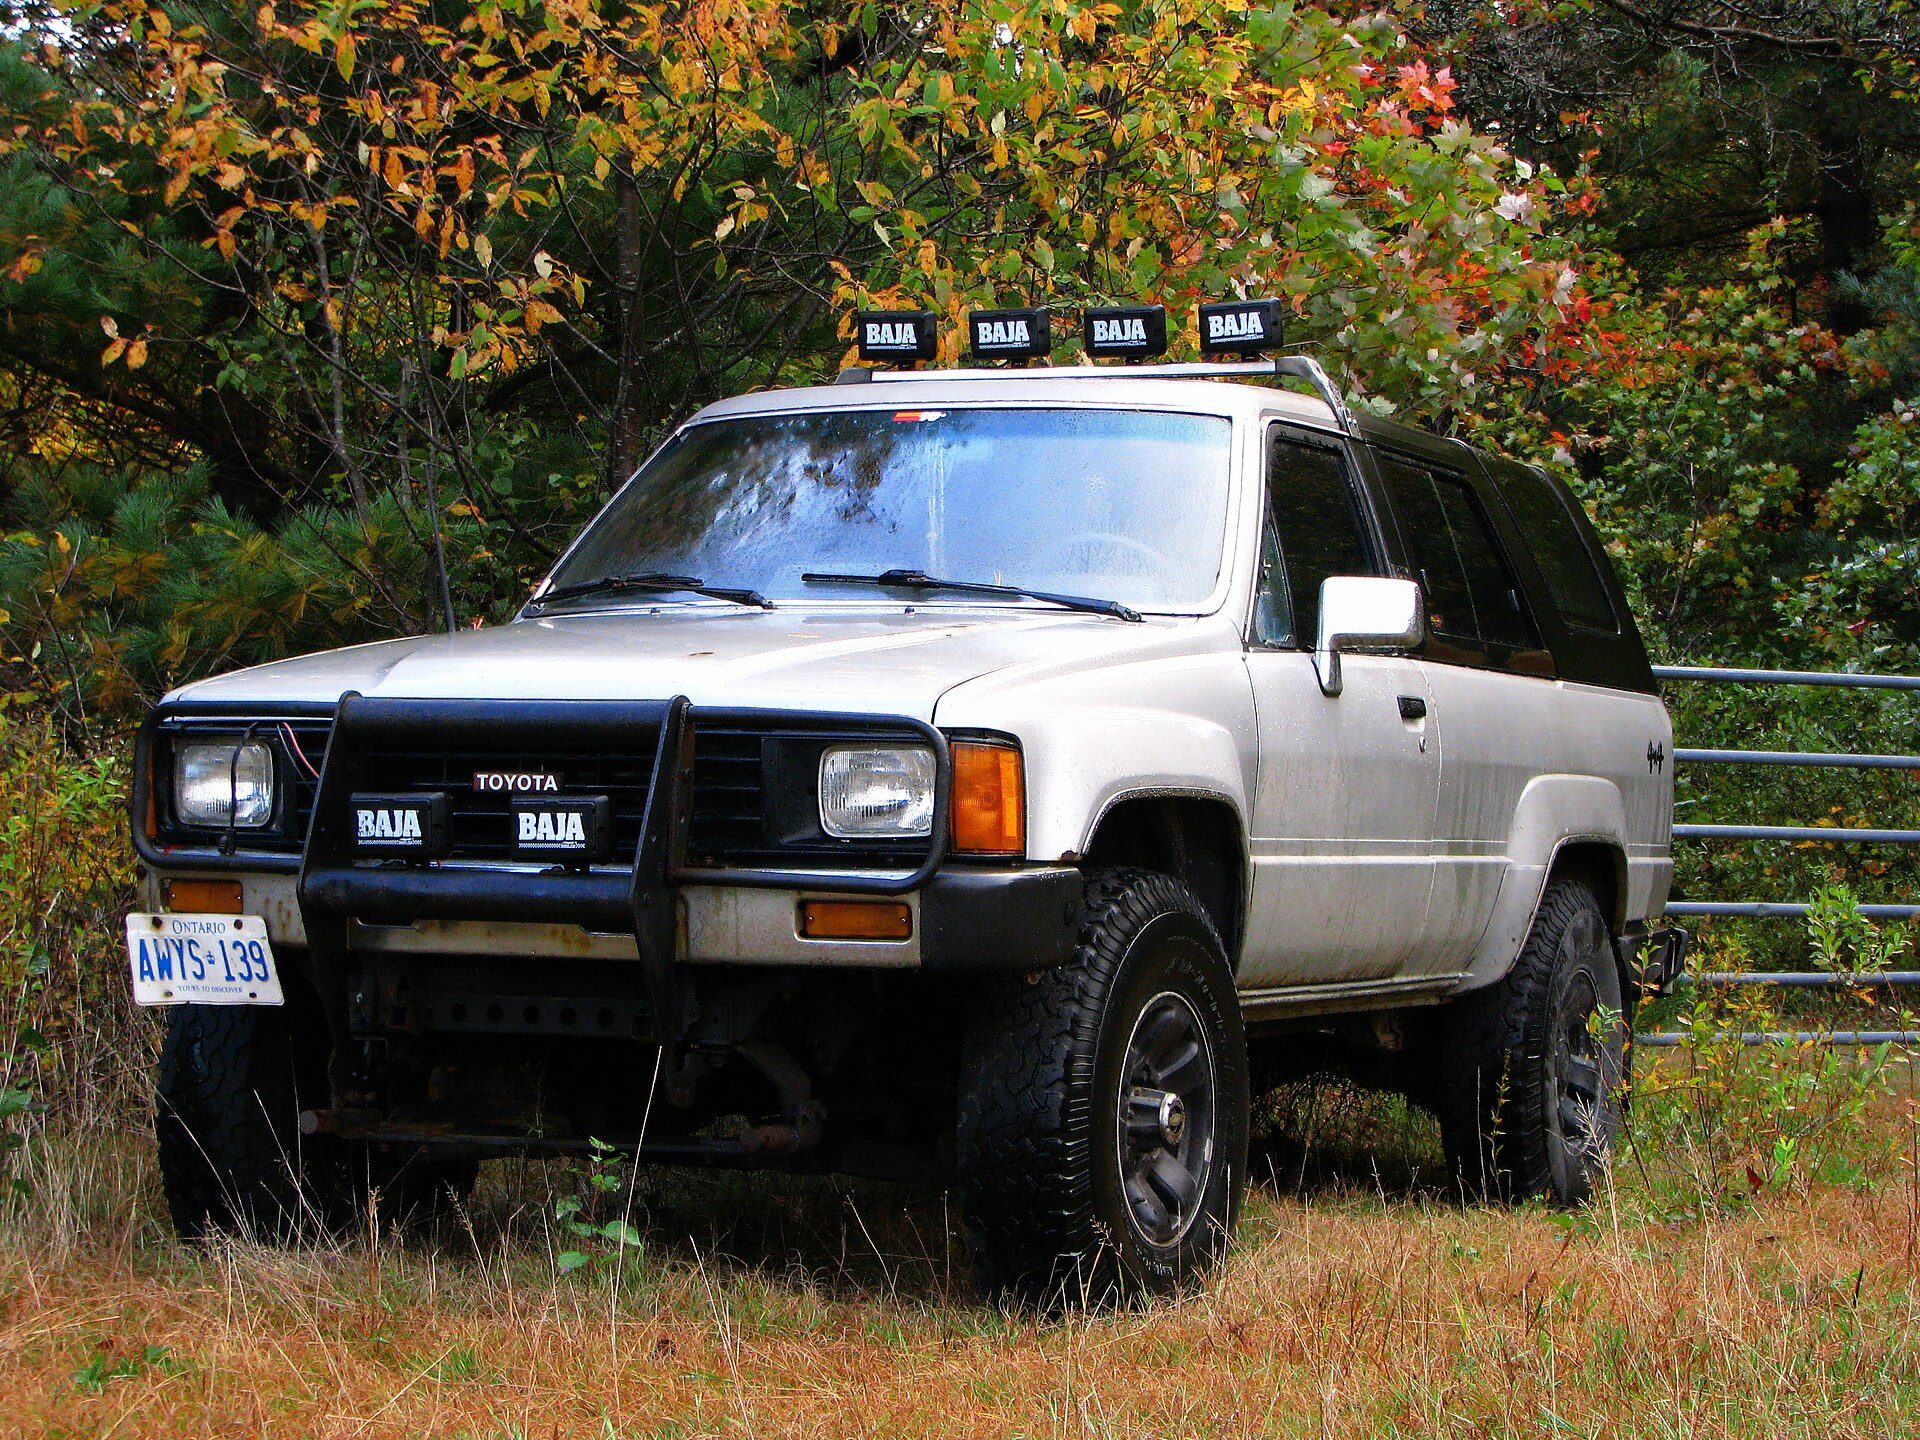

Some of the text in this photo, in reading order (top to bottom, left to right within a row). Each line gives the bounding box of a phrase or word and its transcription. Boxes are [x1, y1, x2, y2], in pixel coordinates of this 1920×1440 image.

[866, 323, 917, 344] BAJA
[977, 321, 1030, 344] BAJA
[1093, 319, 1147, 342] BAJA
[1208, 312, 1263, 338] BAJA
[476, 773, 558, 791] TOYOTA
[357, 810, 422, 837] BAJA
[518, 813, 585, 841] BAJA
[172, 920, 226, 935] ONTARIO
[218, 939, 270, 982] 139
